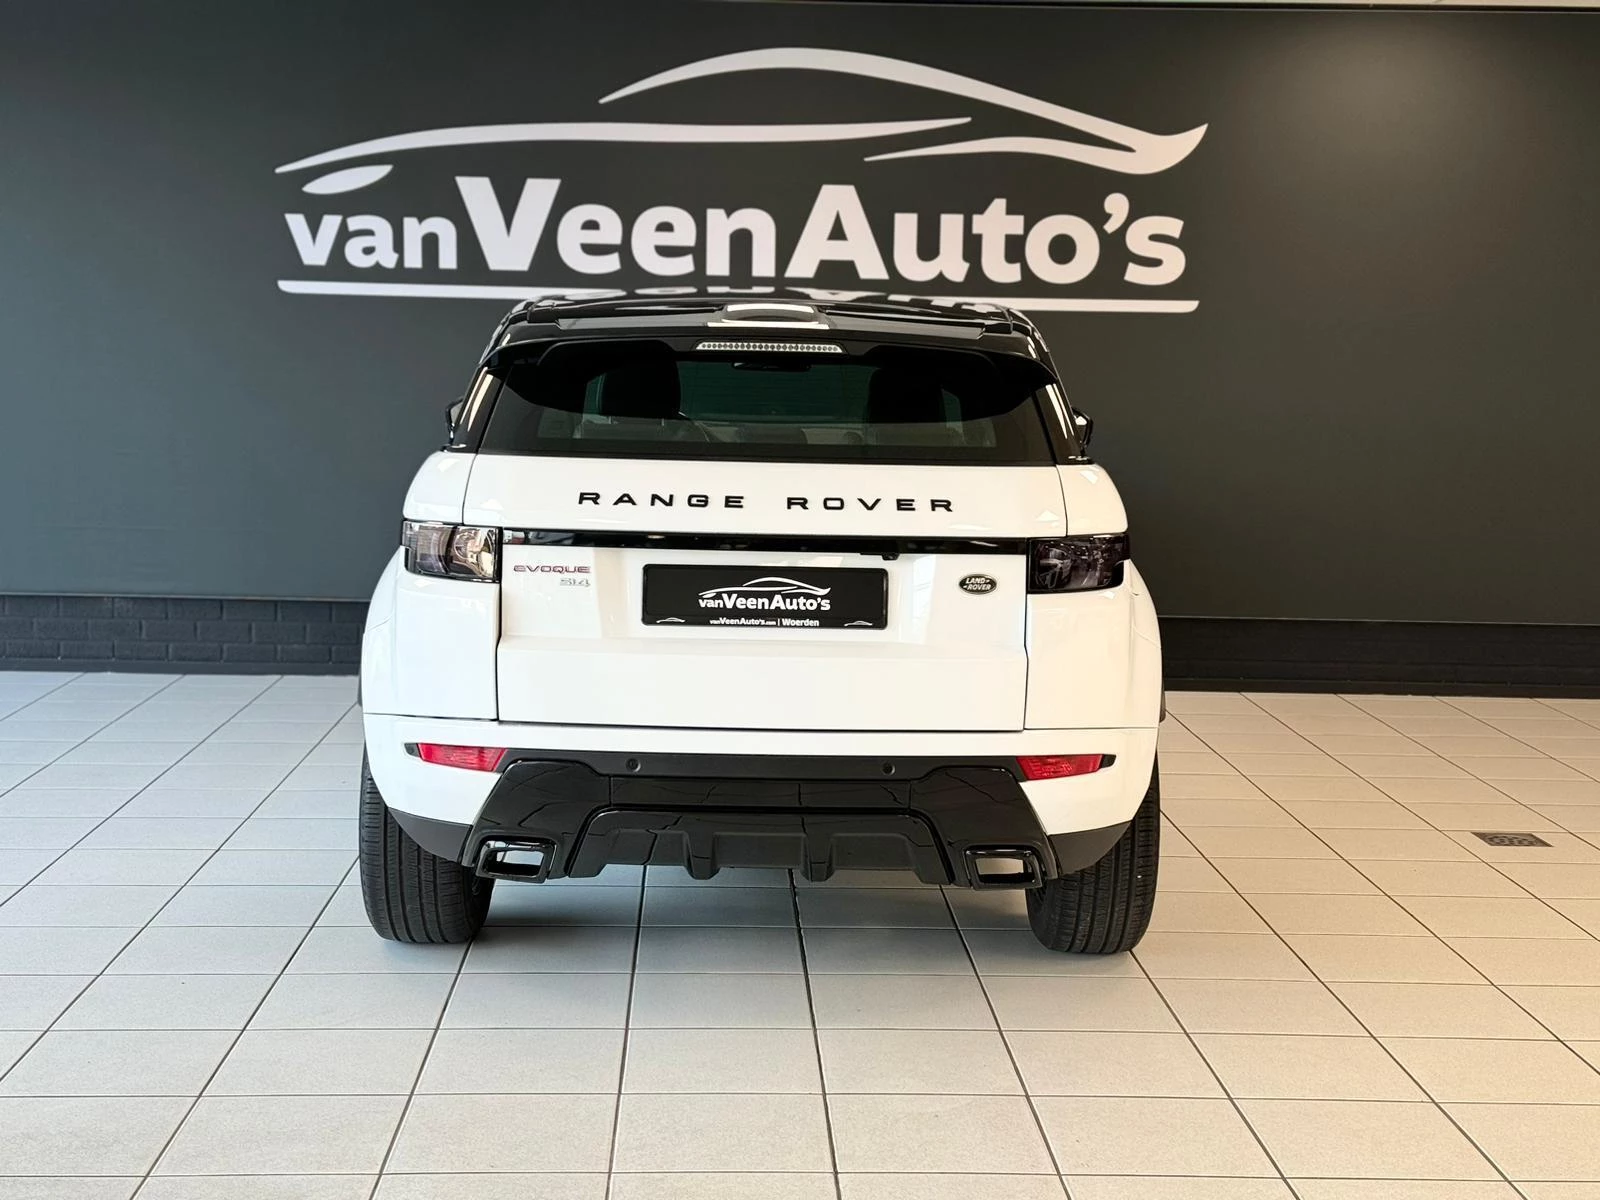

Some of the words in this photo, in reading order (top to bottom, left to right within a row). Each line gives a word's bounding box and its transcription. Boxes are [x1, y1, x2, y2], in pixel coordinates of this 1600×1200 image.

[578, 492, 744, 509] RANGE
[786, 496, 953, 513] ROVER
[513, 565, 591, 575] EVOQUE
[782, 618, 820, 628] Woerden
